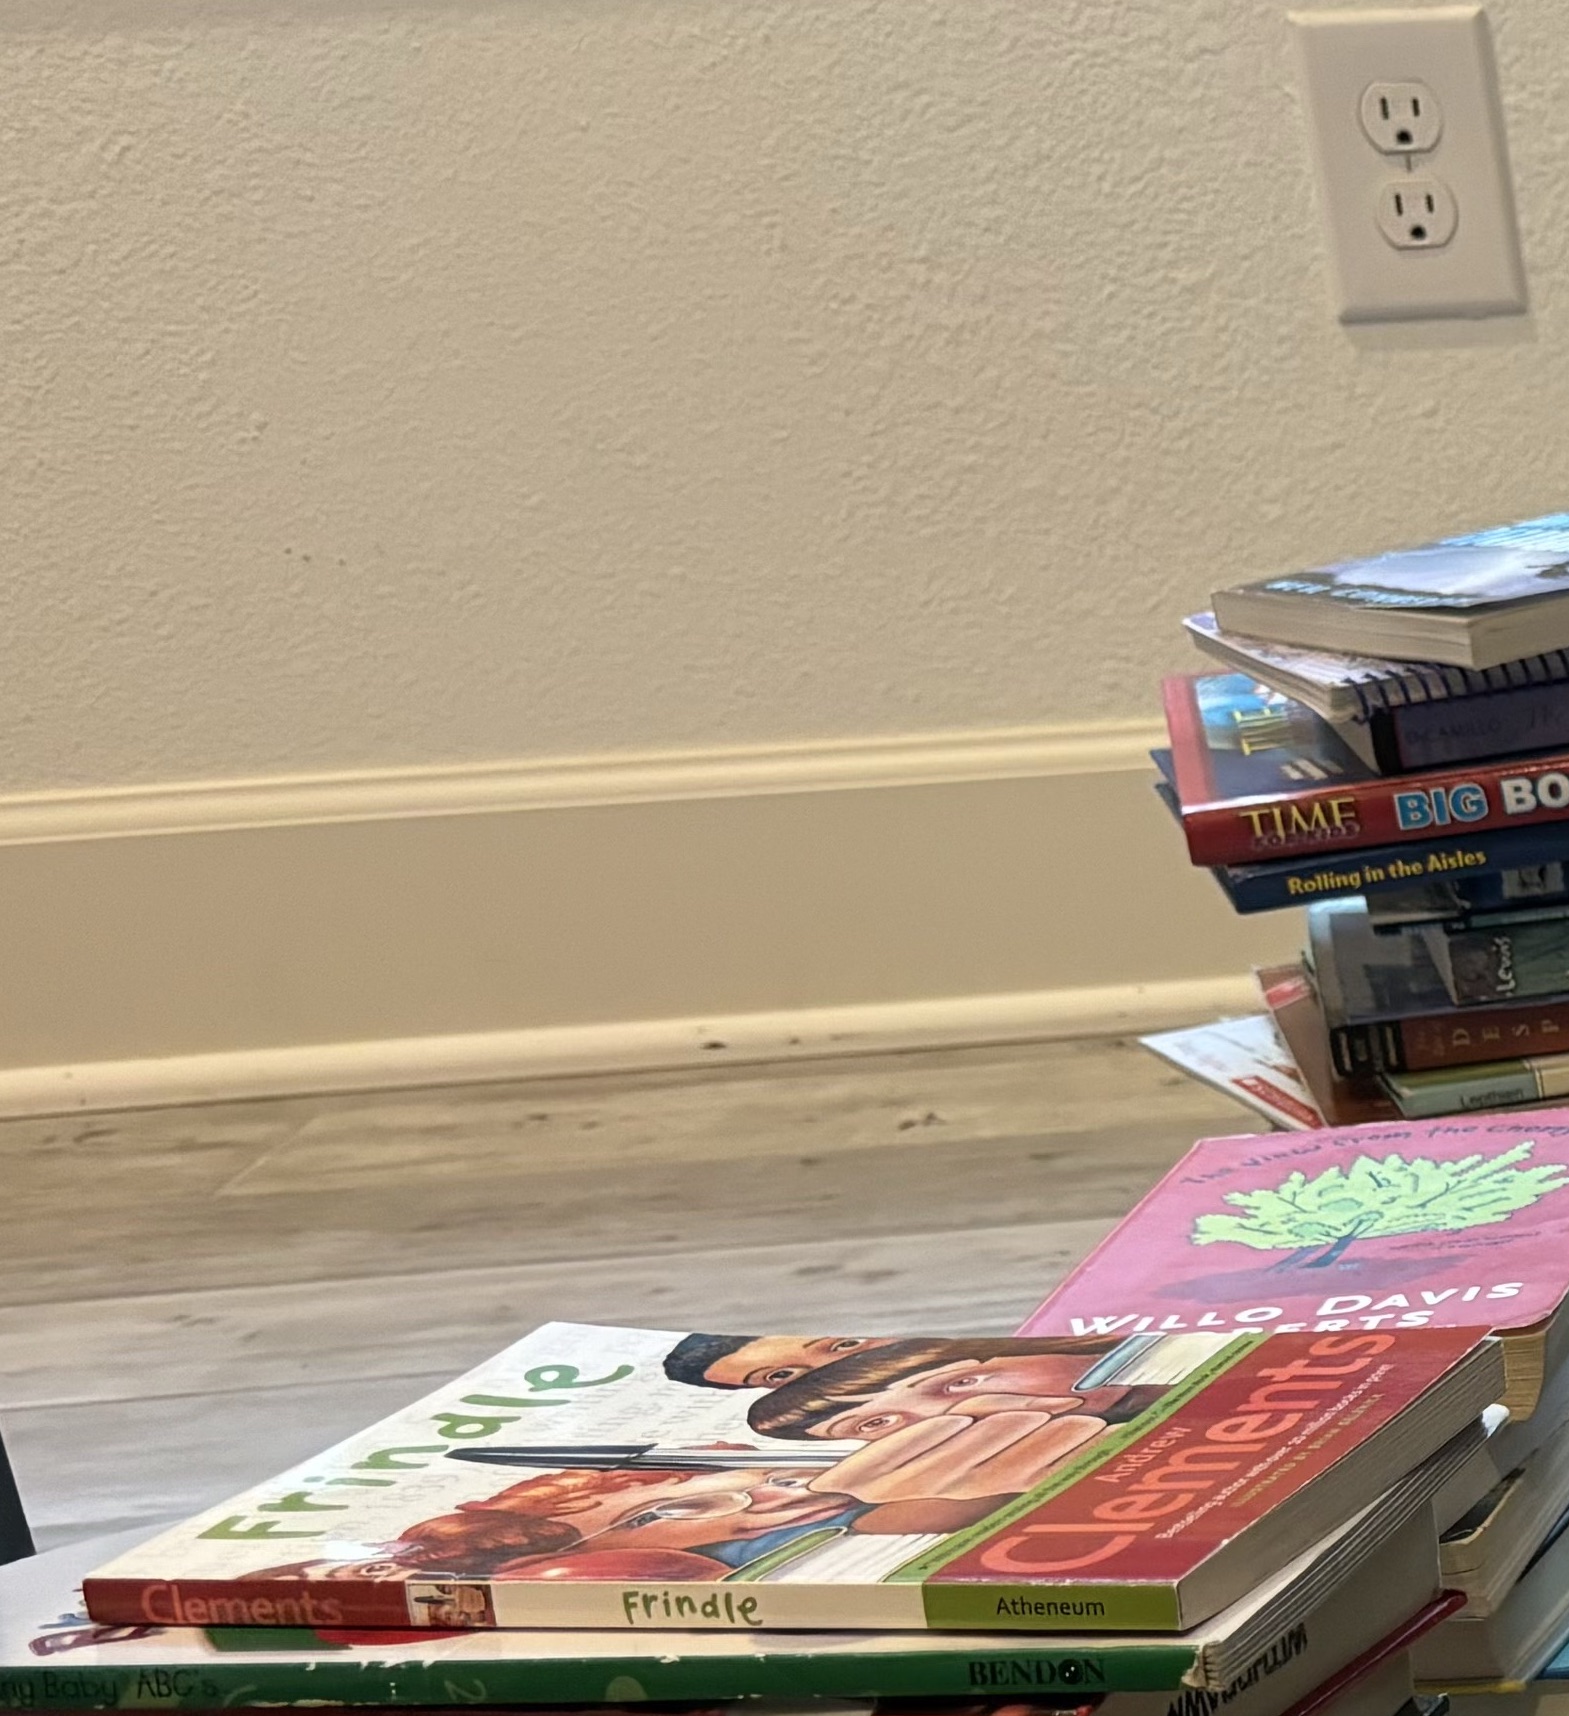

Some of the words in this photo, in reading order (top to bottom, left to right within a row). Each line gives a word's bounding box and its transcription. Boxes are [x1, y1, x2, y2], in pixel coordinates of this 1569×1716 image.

[1238, 796, 1357, 842] TIME
[1395, 784, 1492, 832] BIG
[1286, 866, 1363, 898] Rolling
[1366, 864, 1385, 884] in
[1386, 856, 1425, 884] the
[1426, 848, 1488, 874] Aisles
[1069, 1305, 1285, 1338] WILLO
[1315, 1281, 1524, 1318] DAVIS
[196, 1360, 637, 1542] Frindle
[979, 1332, 1398, 1575] Clements
[142, 1584, 344, 1627] Clements
[622, 1588, 764, 1626] Frindle
[995, 1595, 1107, 1617] Atheneum
[967, 1657, 1106, 1687] BENDON
